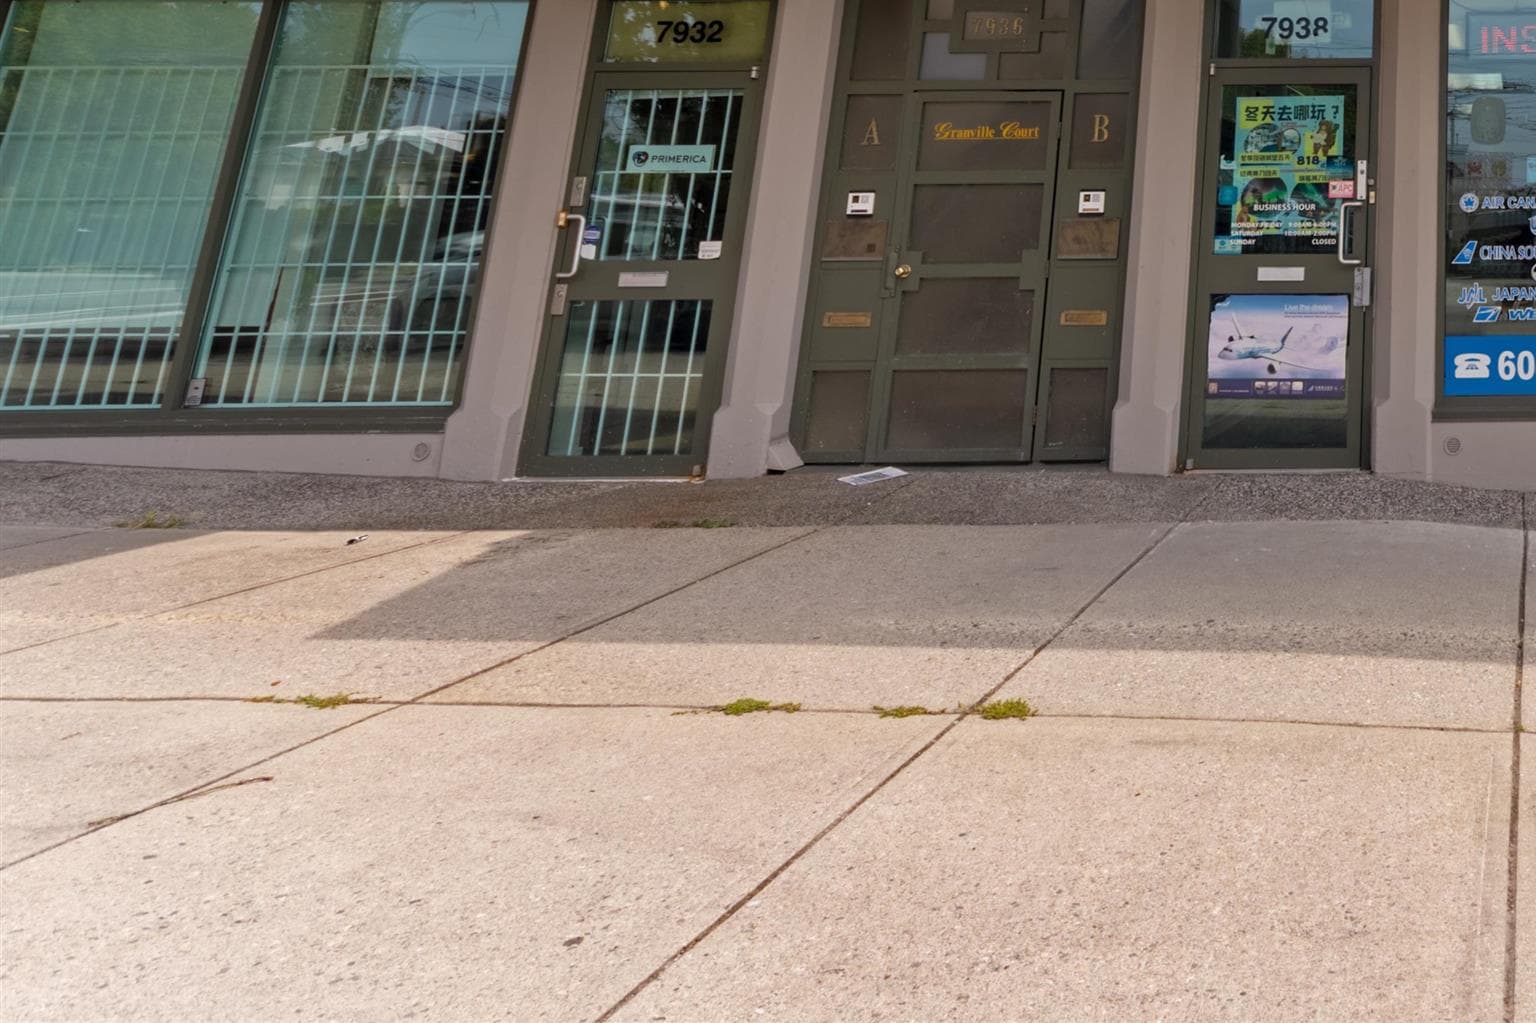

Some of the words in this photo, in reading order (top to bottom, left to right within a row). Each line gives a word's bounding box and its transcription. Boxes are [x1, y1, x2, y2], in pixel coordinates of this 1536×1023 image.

[655, 20, 725, 44] 7932
[861, 117, 882, 145] A
[934, 121, 996, 139] Granville
[1000, 120, 1040, 139] Court
[1092, 115, 1109, 143] B
[650, 154, 707, 164] PRIMERICA
[1253, 203, 1291, 211] BUSINESS
[1481, 196, 1505, 209] AIR
[1479, 246, 1517, 261] CHINA
